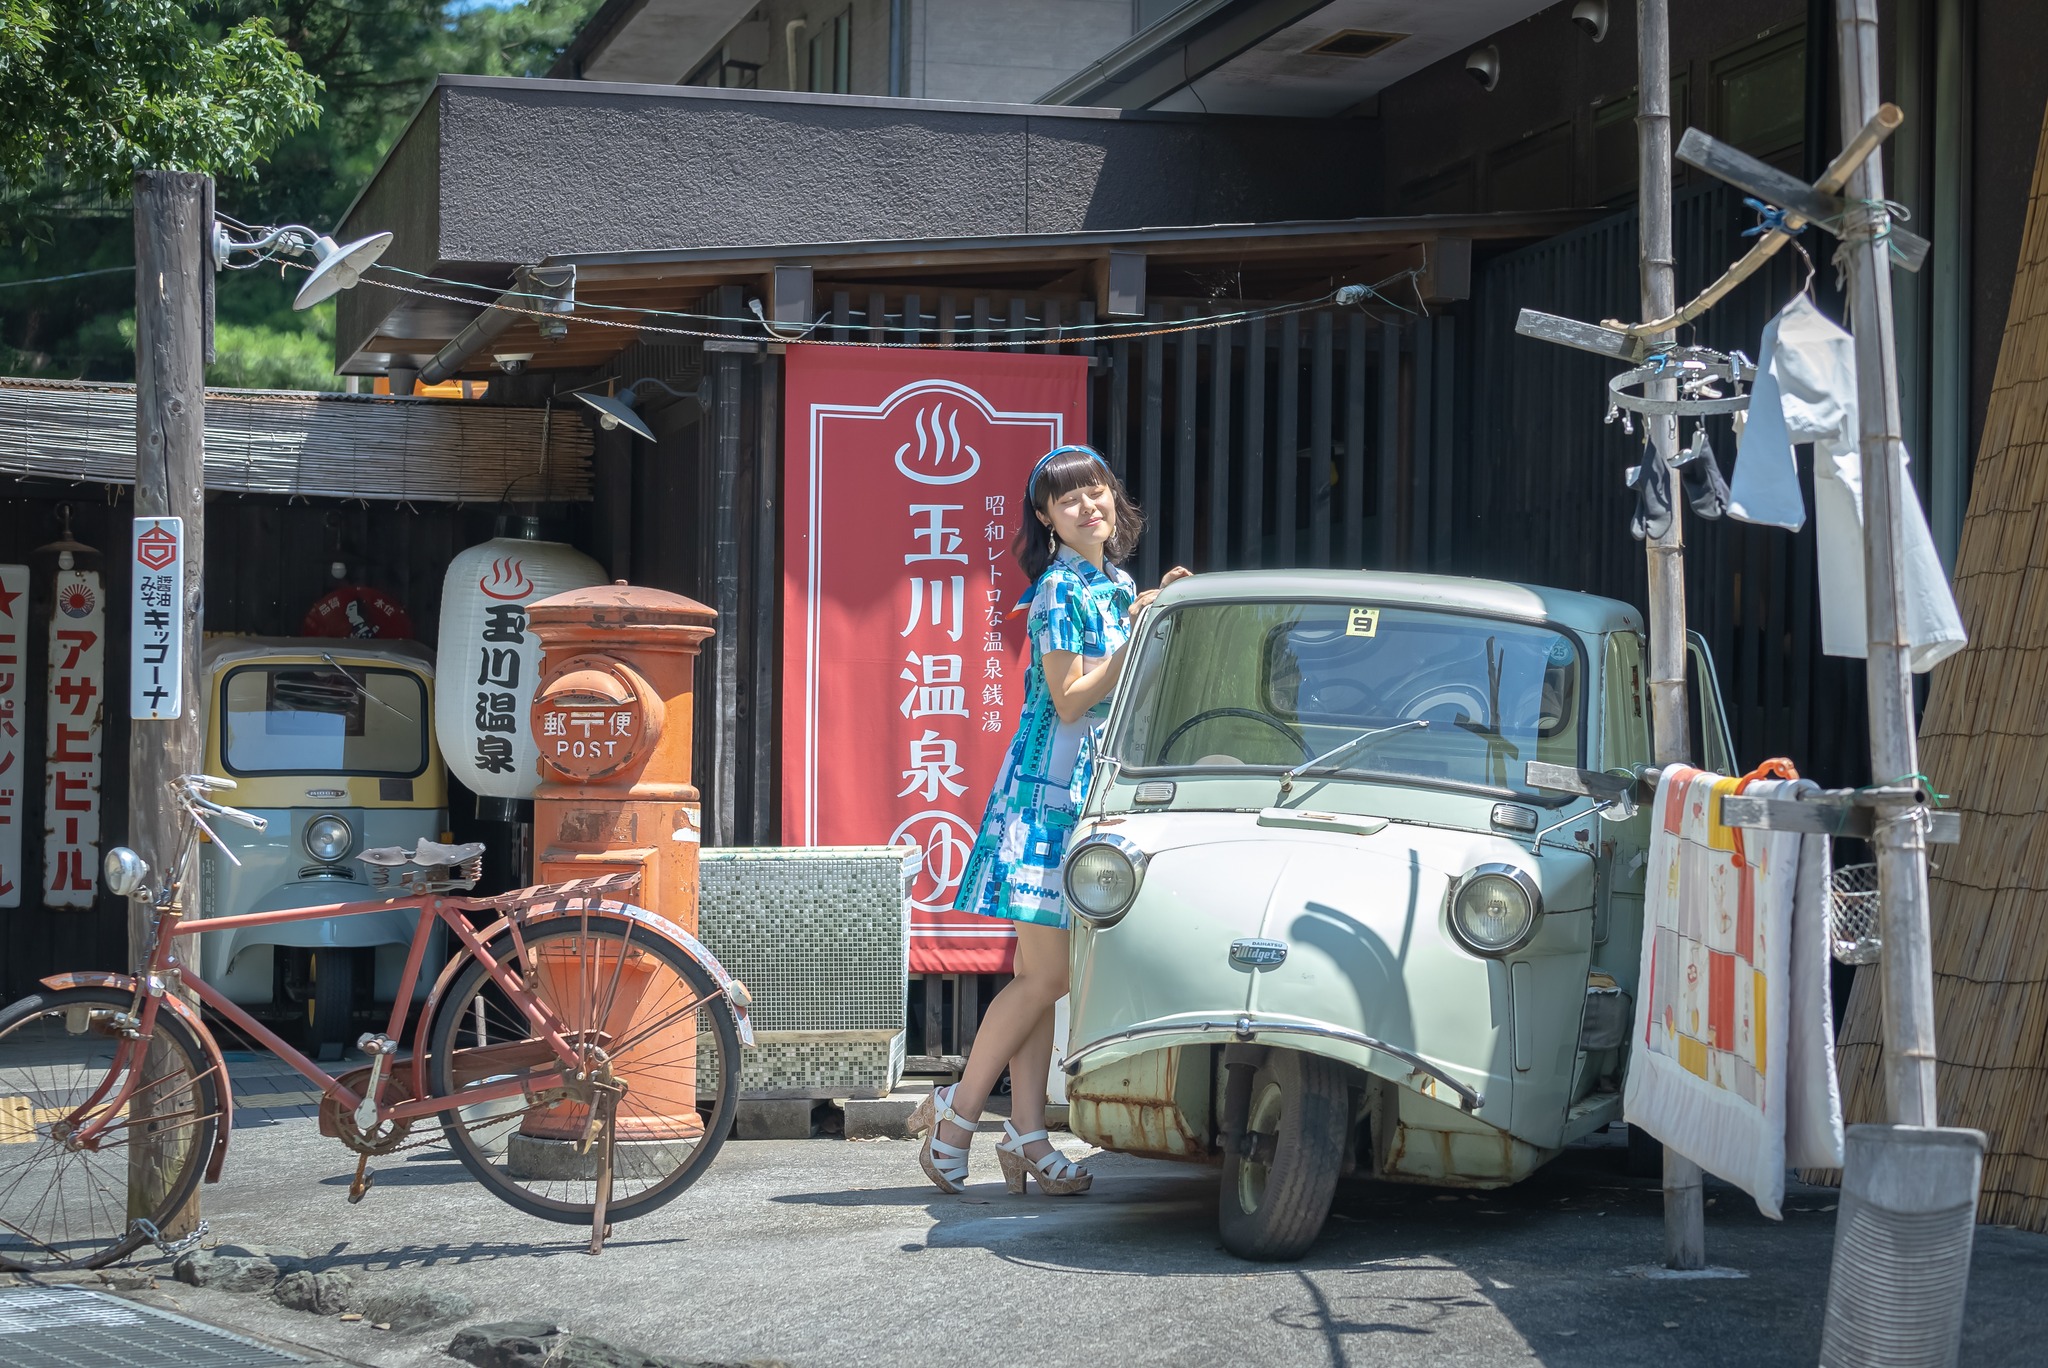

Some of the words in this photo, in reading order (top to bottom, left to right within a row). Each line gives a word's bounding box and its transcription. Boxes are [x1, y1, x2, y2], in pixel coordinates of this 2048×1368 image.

[140, 576, 157, 607] みそ
[981, 495, 1005, 733] 昭和レトロな温泉銭湯
[142, 609, 170, 709] キッコーナ
[474, 604, 526, 774] 玉川温泉
[896, 504, 969, 802] 玉川温泉
[1553, 648, 1565, 658] 25
[50, 630, 98, 891] アサヒビール
[557, 741, 617, 758] POST
[900, 821, 973, 903] ゆ
[1233, 943, 1281, 962] Midget
